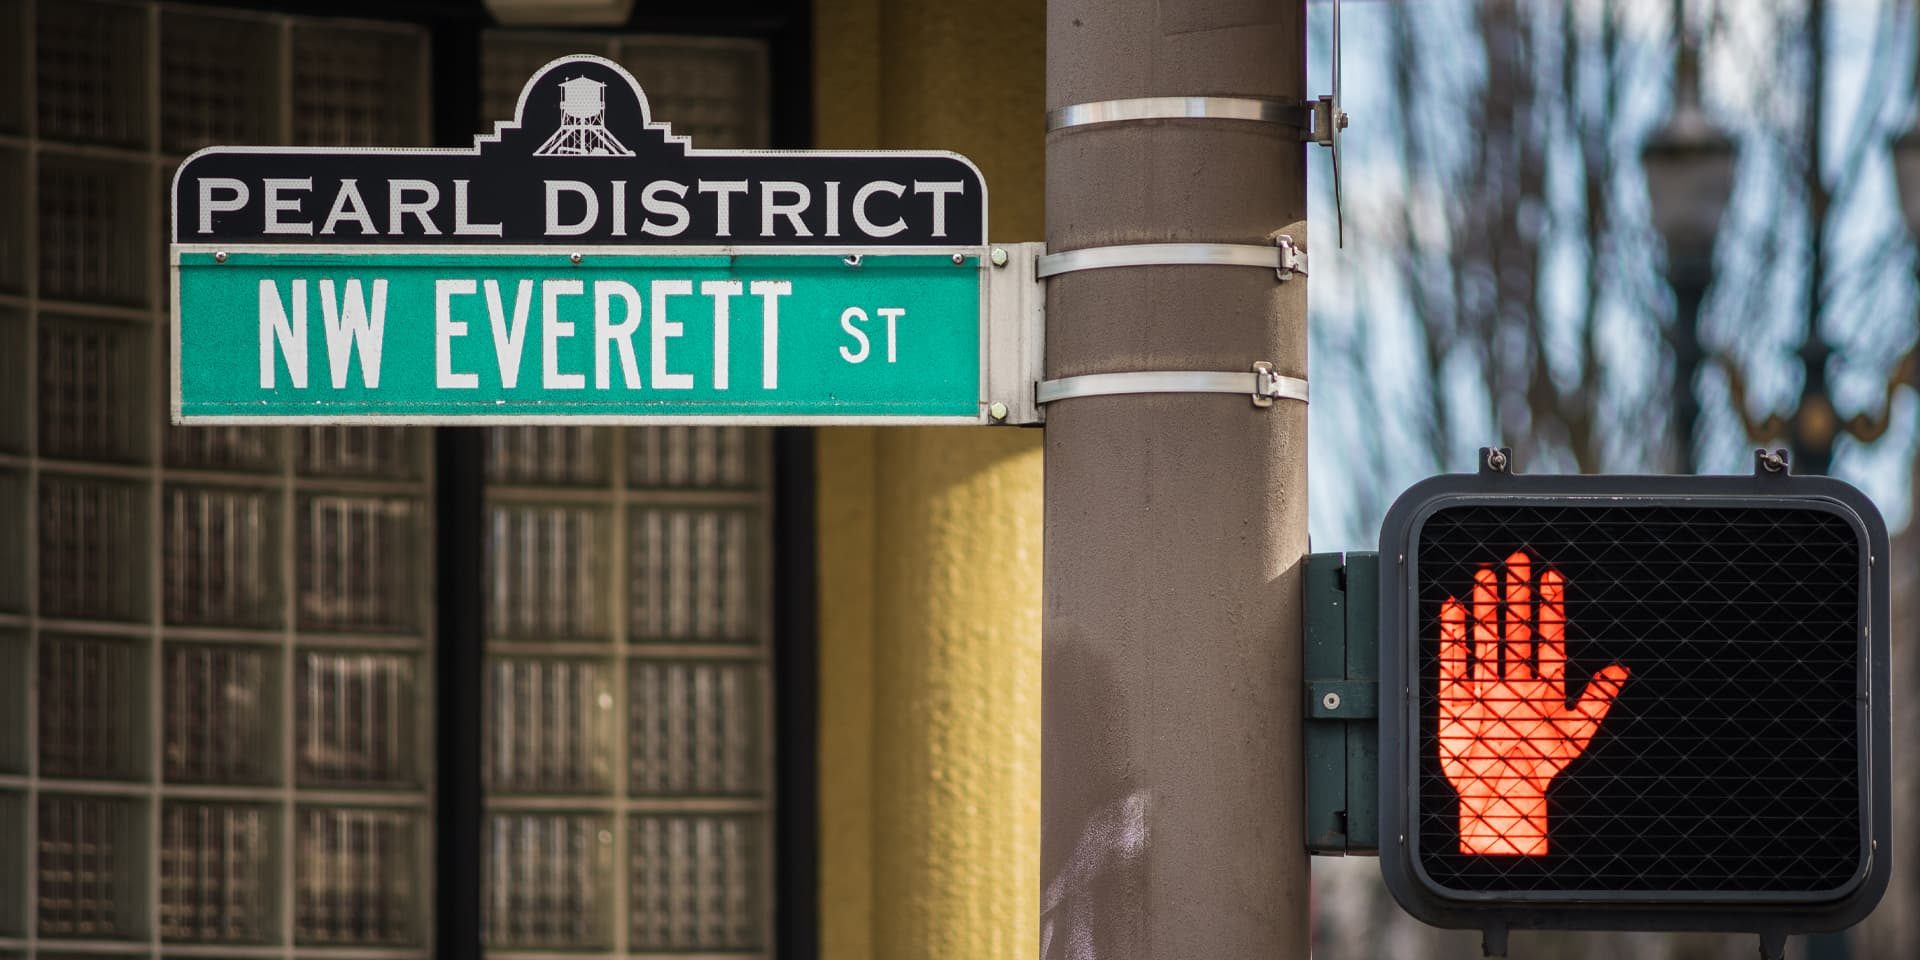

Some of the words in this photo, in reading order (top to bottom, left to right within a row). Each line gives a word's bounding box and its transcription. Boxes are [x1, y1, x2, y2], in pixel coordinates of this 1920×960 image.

[197, 177, 503, 237] PEARL
[543, 179, 965, 238] DISTRICT
[258, 279, 389, 390] NW
[435, 279, 793, 390] EVERETT
[839, 306, 906, 364] ST
